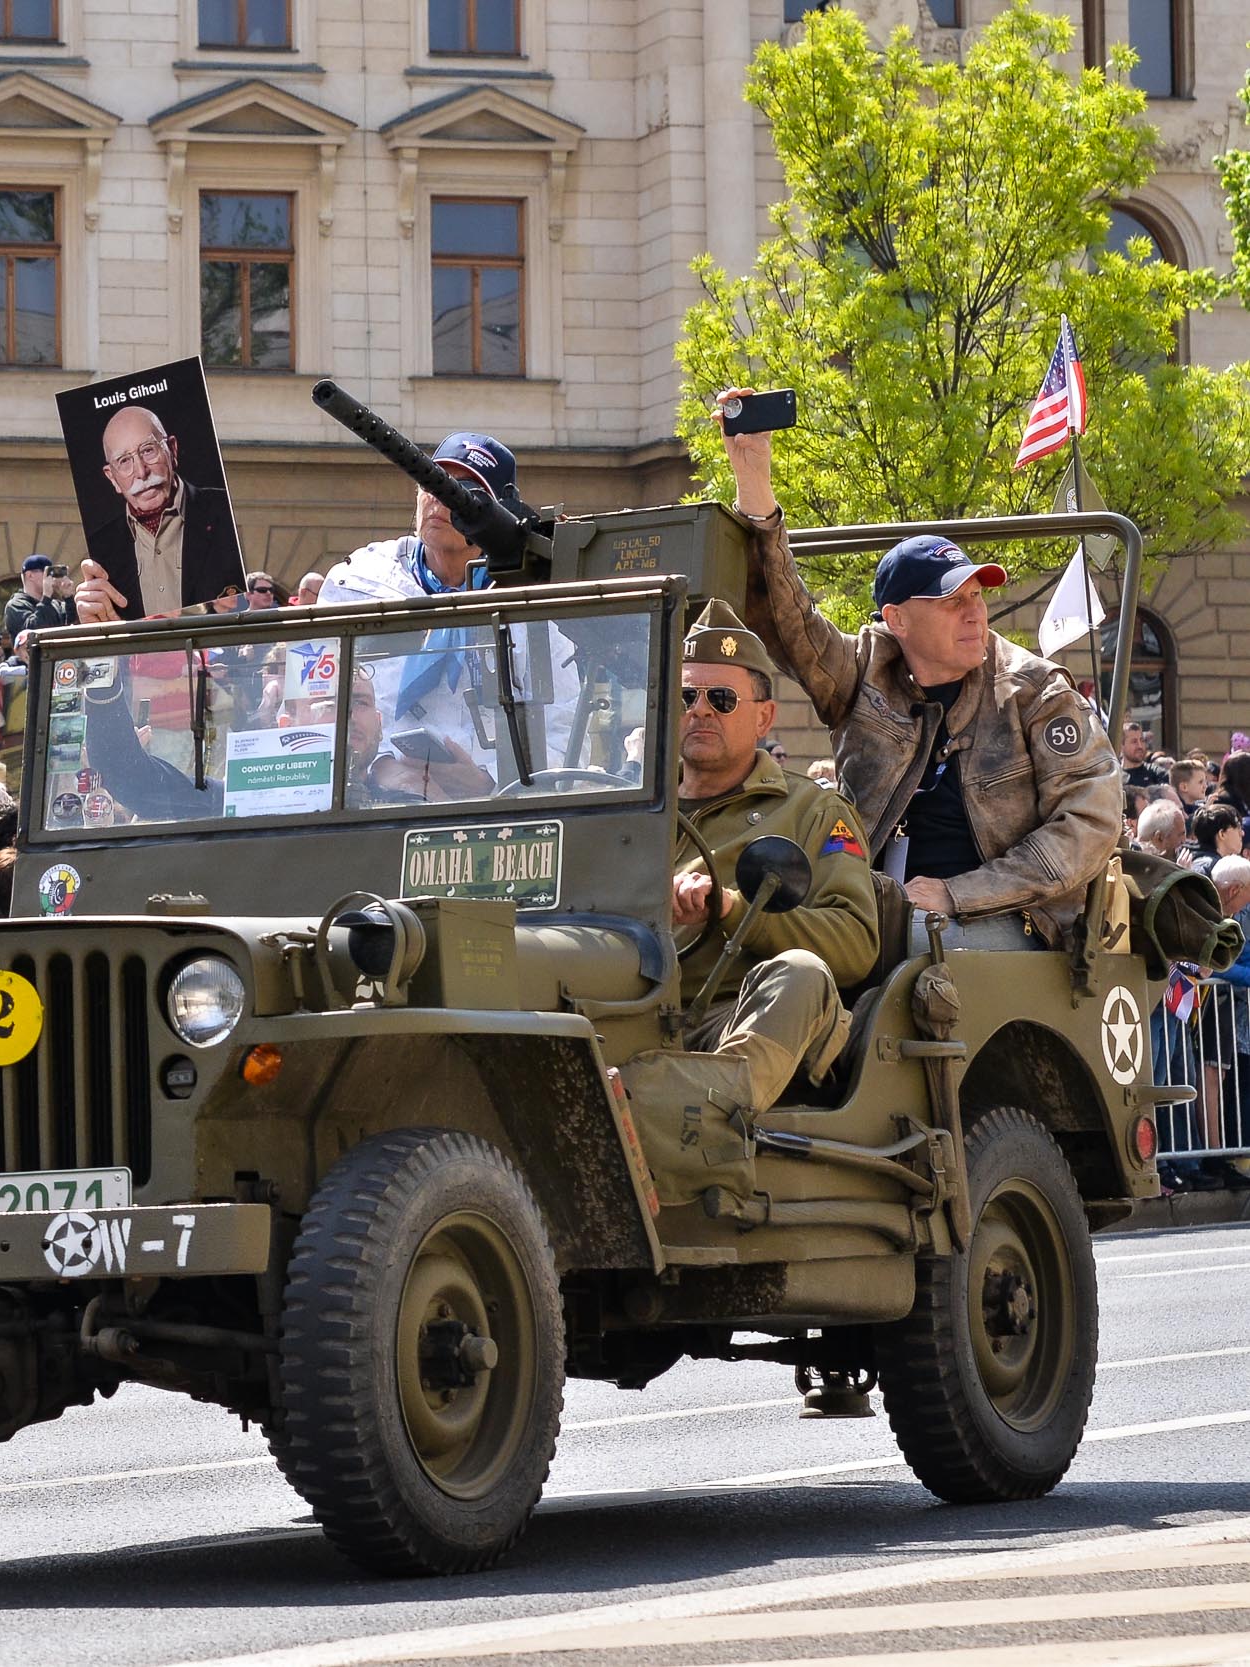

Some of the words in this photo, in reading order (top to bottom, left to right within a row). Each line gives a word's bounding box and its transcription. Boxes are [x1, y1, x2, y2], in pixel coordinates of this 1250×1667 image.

[93, 392, 127, 409] Louis
[129, 378, 168, 399] Gihoul
[1051, 724, 1078, 746] 59
[241, 763, 273, 774] CONVOY
[275, 763, 286, 771] OF
[286, 760, 318, 770] LIBERTY
[276, 772, 311, 783] Republiky
[835, 825, 847, 833] 16
[409, 846, 474, 888] OMAHA
[491, 841, 554, 882] BEACH
